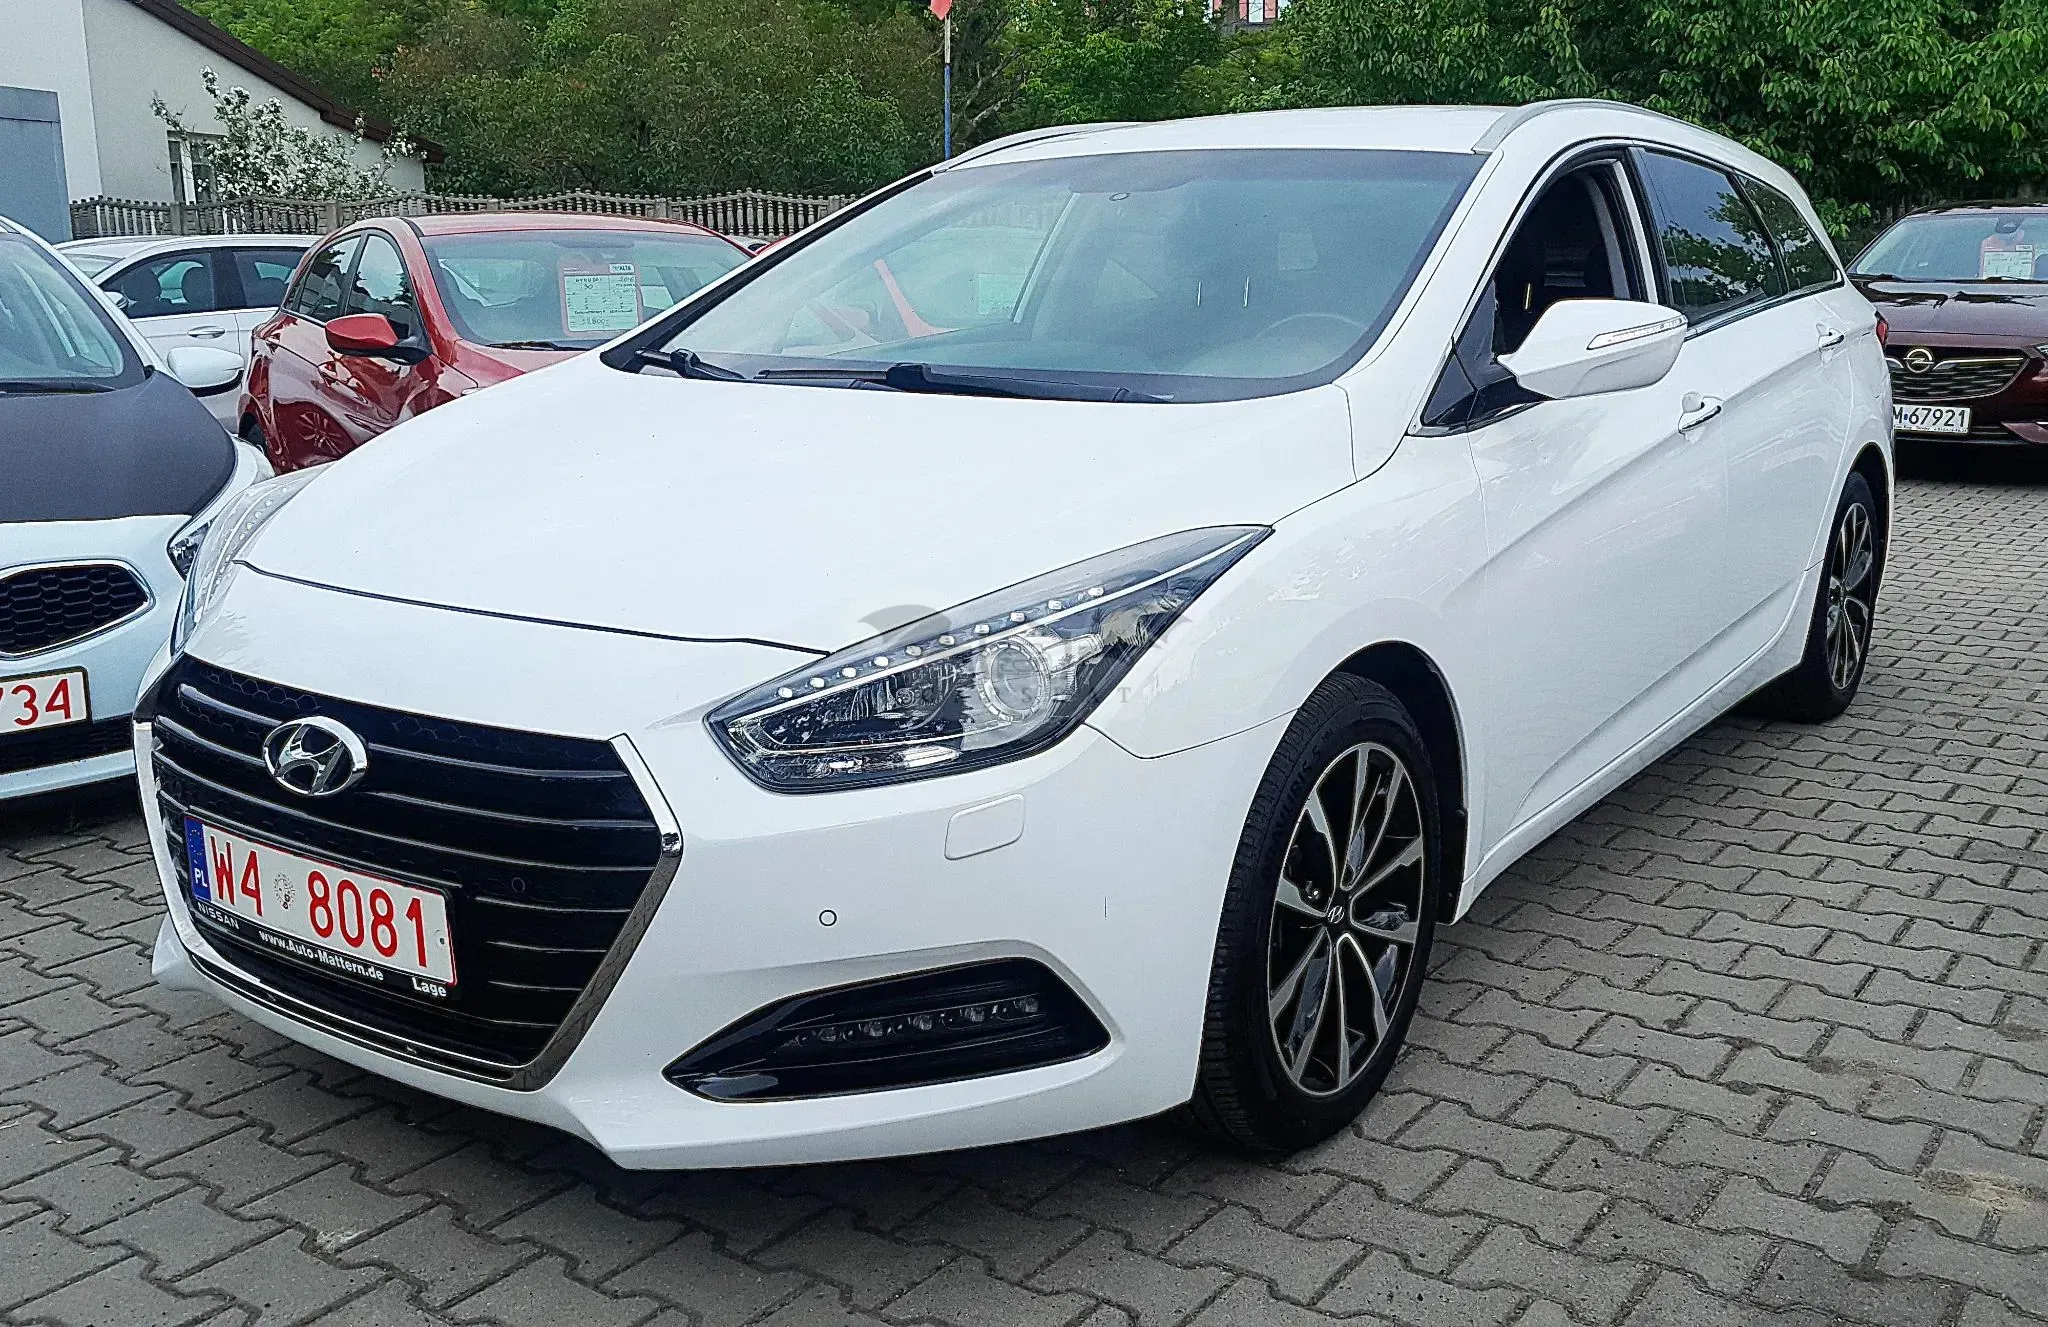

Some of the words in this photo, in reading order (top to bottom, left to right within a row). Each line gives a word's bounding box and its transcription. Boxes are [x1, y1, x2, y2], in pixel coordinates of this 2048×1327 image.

[1908, 407, 1966, 428] 67921
[194, 867, 208, 887] PL
[210, 835, 263, 917] W4
[307, 870, 427, 968] 8081
[197, 901, 240, 930] NISSAN
[258, 930, 384, 981] www.Auto-Mattern.de
[411, 976, 447, 997] Lage
